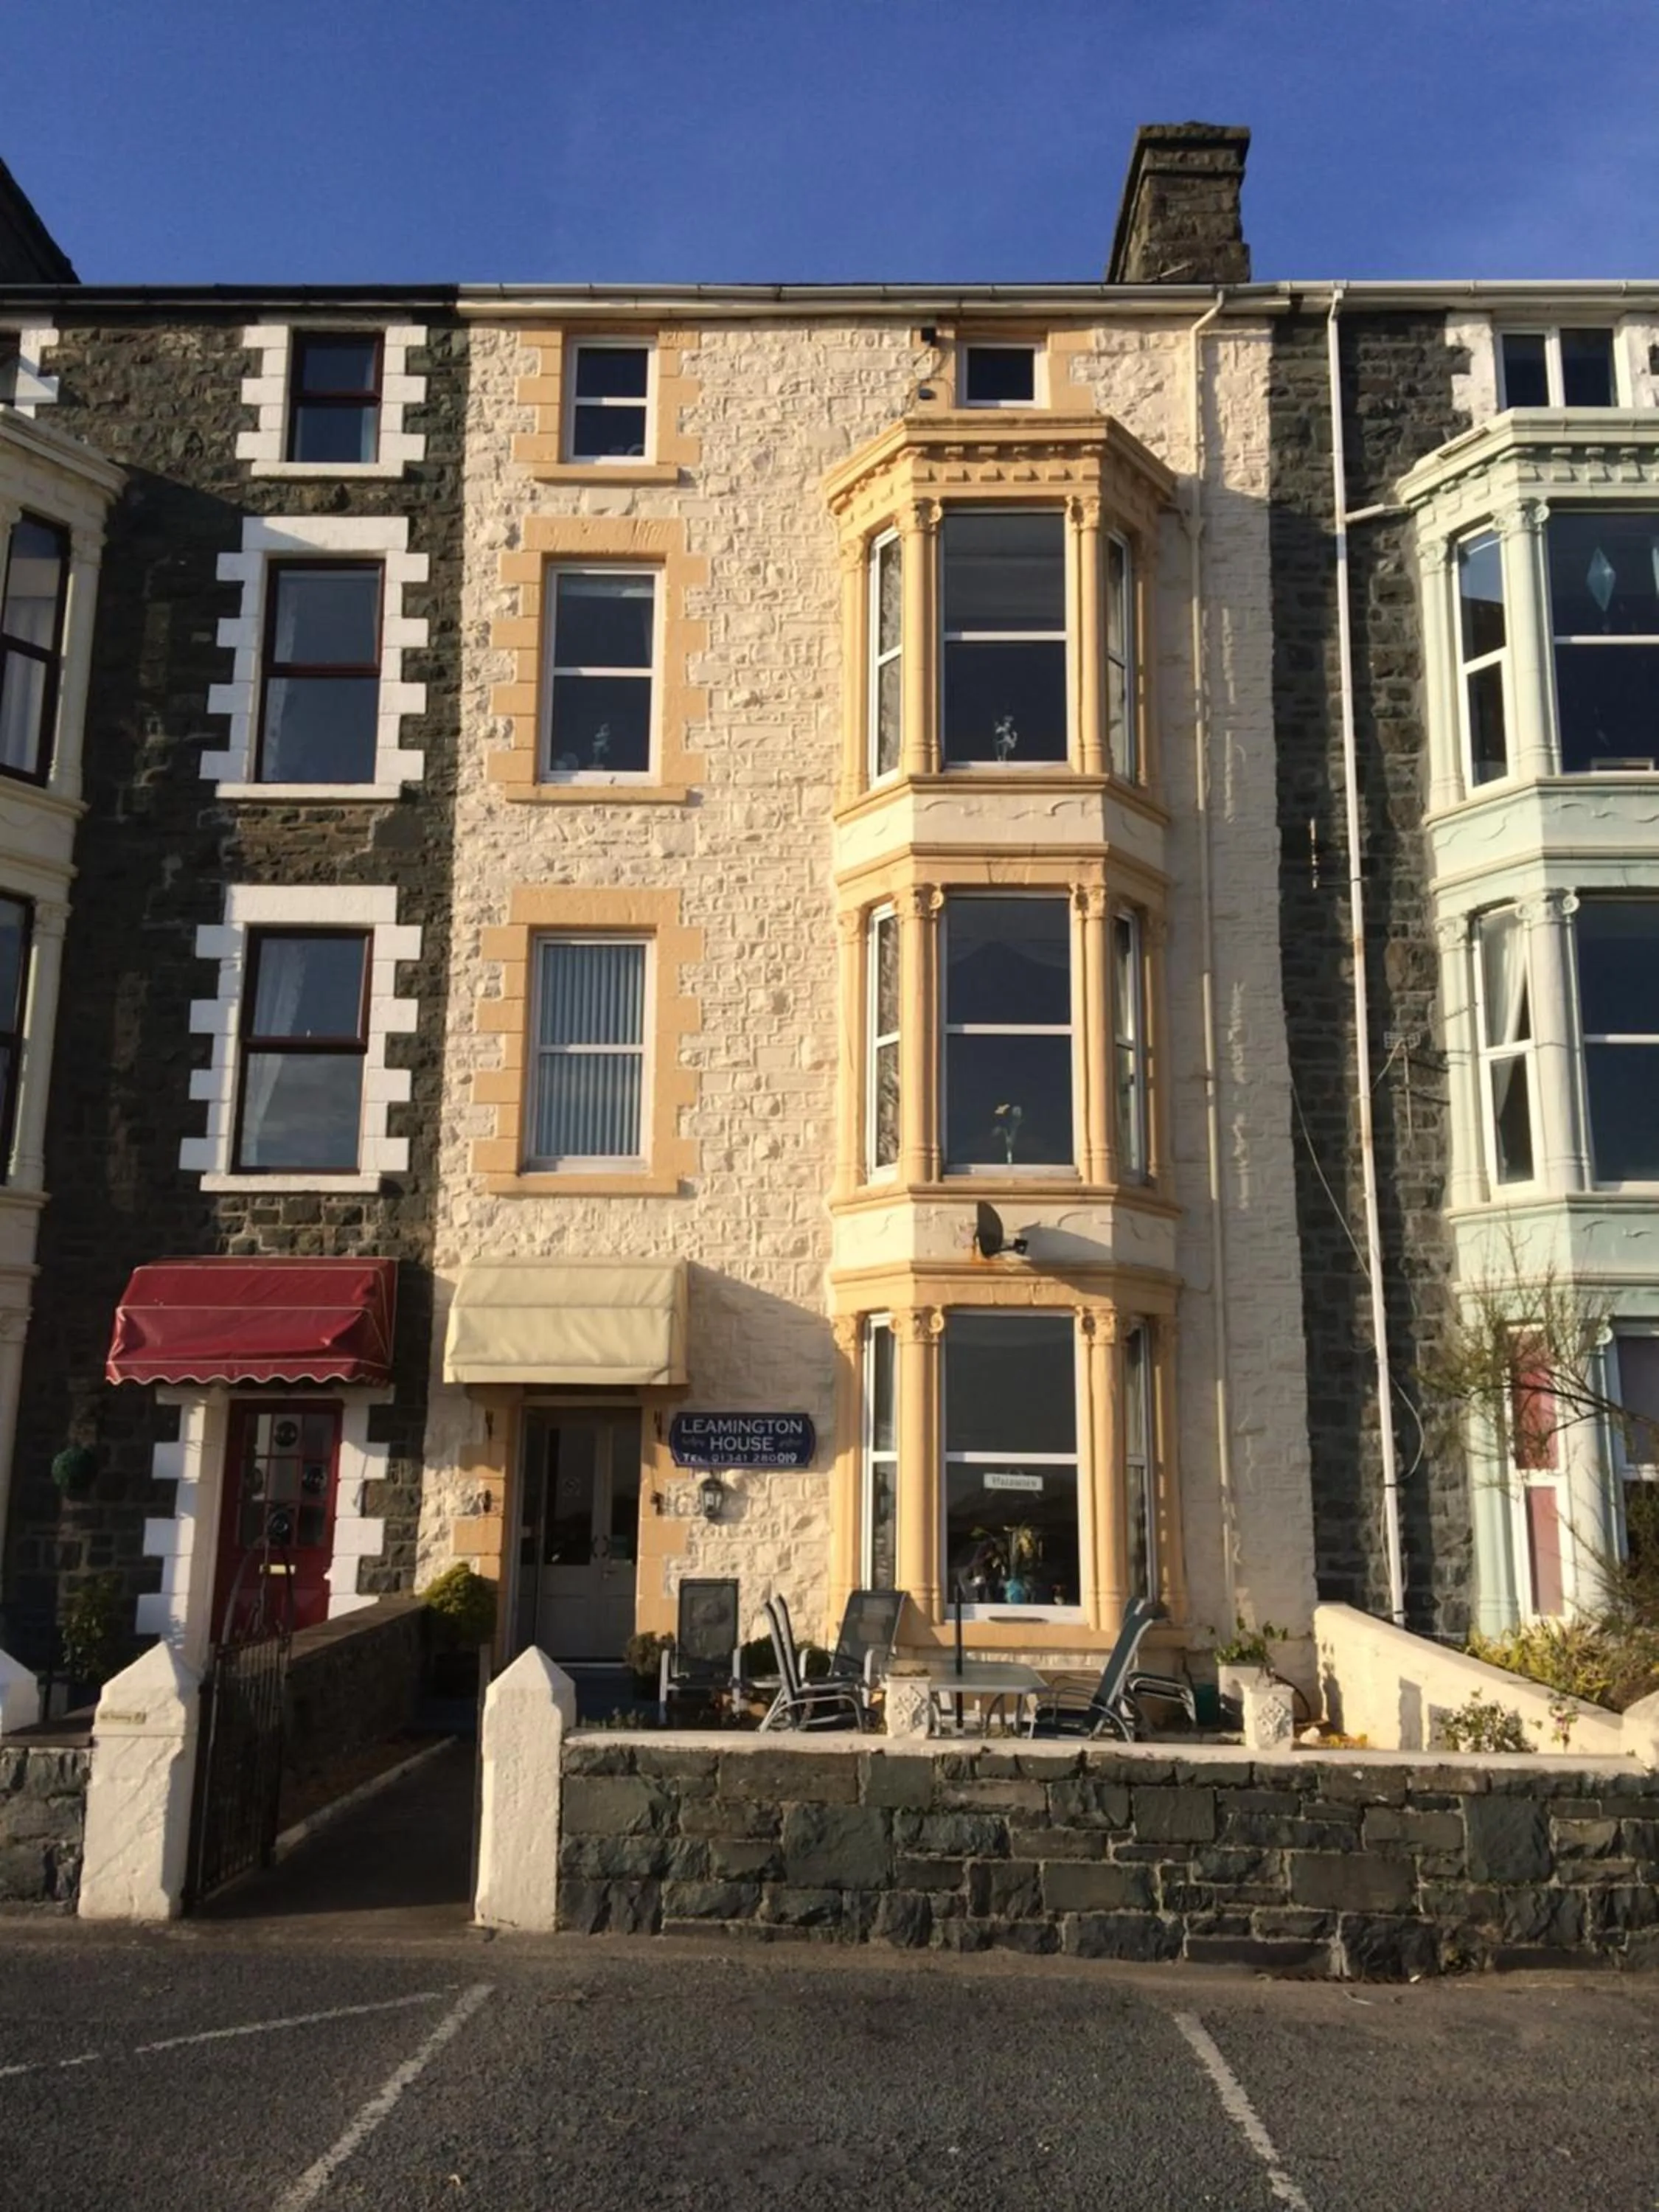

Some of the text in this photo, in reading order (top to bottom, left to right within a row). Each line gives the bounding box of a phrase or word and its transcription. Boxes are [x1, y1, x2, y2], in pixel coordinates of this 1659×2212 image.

[681, 1419, 803, 1434] LEAMINGTON
[710, 1436, 773, 1452] HOUSE
[712, 1453, 748, 1463] 01341
